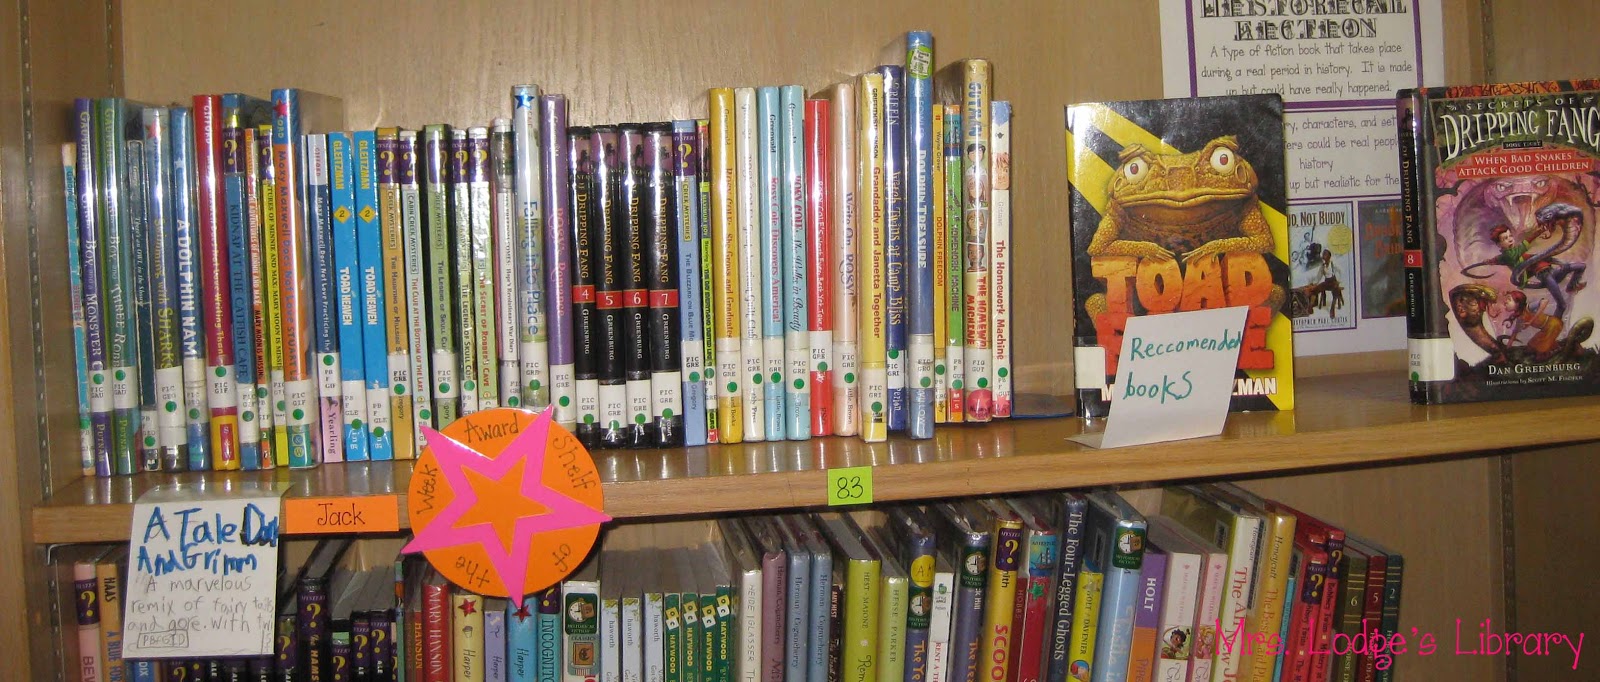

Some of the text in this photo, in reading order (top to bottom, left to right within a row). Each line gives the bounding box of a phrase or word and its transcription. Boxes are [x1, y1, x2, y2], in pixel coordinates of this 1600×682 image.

[1233, 18, 1379, 41] FICTION
[1210, 40, 1403, 62] A type of fiction book that takes place
[1201, 60, 1413, 81] during real period in history. It made
[1260, 80, 1393, 97] could have really happened.
[1466, 97, 1575, 110] SECRETS OF
[1302, 116, 1358, 131] characters,
[1360, 115, 1377, 128] and
[1440, 110, 1540, 161] DRIPPING
[1307, 139, 1331, 151] could
[1334, 138, 1346, 149] be
[1350, 137, 1370, 149] real
[1475, 152, 1573, 165] WHEN SNAKES
[333, 140, 344, 190] GLEITZMAN
[359, 140, 370, 190] GLEITZMAN
[1299, 158, 1334, 172] history
[1458, 162, 1590, 177] ATTACK GOOD CHILDREN
[872, 167, 882, 224] Grandaddy
[1289, 174, 1379, 192] up but realistic for
[1300, 210, 1346, 226] NOT BUDDY
[1402, 160, 1414, 244] DRIPPING FANG
[683, 204, 692, 240] MYSTERIES
[873, 227, 882, 246] and
[918, 204, 928, 269] TREASURE
[410, 237, 418, 273] MYSTERIES
[578, 193, 590, 285] DRIPPING FANG
[630, 197, 642, 283] DRIPPING FANG
[659, 197, 670, 283] DRIPPING FANG
[520, 201, 542, 336] Falling into Place
[771, 228, 782, 323] Discovers America!
[886, 207, 905, 326] Twins Camp Bliss
[936, 251, 944, 287] FREEDOM
[1407, 254, 1414, 265] 8
[178, 236, 197, 359] DOLPHIN NAM
[229, 204, 248, 377] KIDNAP THE CATFISH CAFE
[339, 267, 353, 326] TOAD HEAVEN
[365, 266, 378, 325] TOAD HEAVEN
[582, 289, 590, 300] 4
[633, 292, 641, 305] 6
[661, 293, 669, 305] 7
[686, 268, 695, 299] BLIZZARD
[976, 276, 987, 296] THE
[1090, 252, 1273, 316] TOAD
[605, 295, 615, 306] 5
[872, 292, 882, 338] Together
[996, 240, 1006, 360] The Homework Machine
[86, 293, 102, 356] MONSTER
[726, 297, 735, 338] Graduates
[966, 294, 976, 345] MACHINE
[482, 367, 491, 387] CAVE
[328, 412, 338, 455] Yearling
[416, 412, 597, 589] Award Shelf of the Week
[836, 475, 864, 500] 83
[143, 506, 239, 552] A Tale
[317, 502, 366, 526] Jack
[136, 542, 258, 577] And Grimm
[1269, 535, 1284, 579] Honeycutt
[103, 577, 117, 603] HAAS
[170, 575, 252, 592] marvelous
[793, 576, 803, 609] Herman
[863, 571, 871, 592] HEST
[1053, 511, 1083, 662] The Four-Legged Ghosts
[1143, 577, 1157, 611] HOLT
[1232, 566, 1249, 599] The
[1372, 592, 1379, 603] 5
[1389, 588, 1396, 599] 2
[131, 595, 248, 615] remix of fairy
[1015, 589, 1025, 621] HOBBS
[1263, 588, 1279, 609] The
[1350, 598, 1358, 607] 6
[127, 615, 163, 632] and
[430, 590, 443, 675] MARY HANSON
[626, 618, 635, 646] haworth
[652, 614, 661, 643] haworth
[1080, 619, 1091, 655] DAVENIER
[107, 640, 123, 662] BLUE
[705, 631, 713, 672] HAYWOOD
[890, 626, 898, 663] PARKER
[138, 661, 149, 677] DIX
[462, 648, 477, 680] Harper
[493, 655, 504, 680] Harper
[516, 647, 530, 679] Harper
